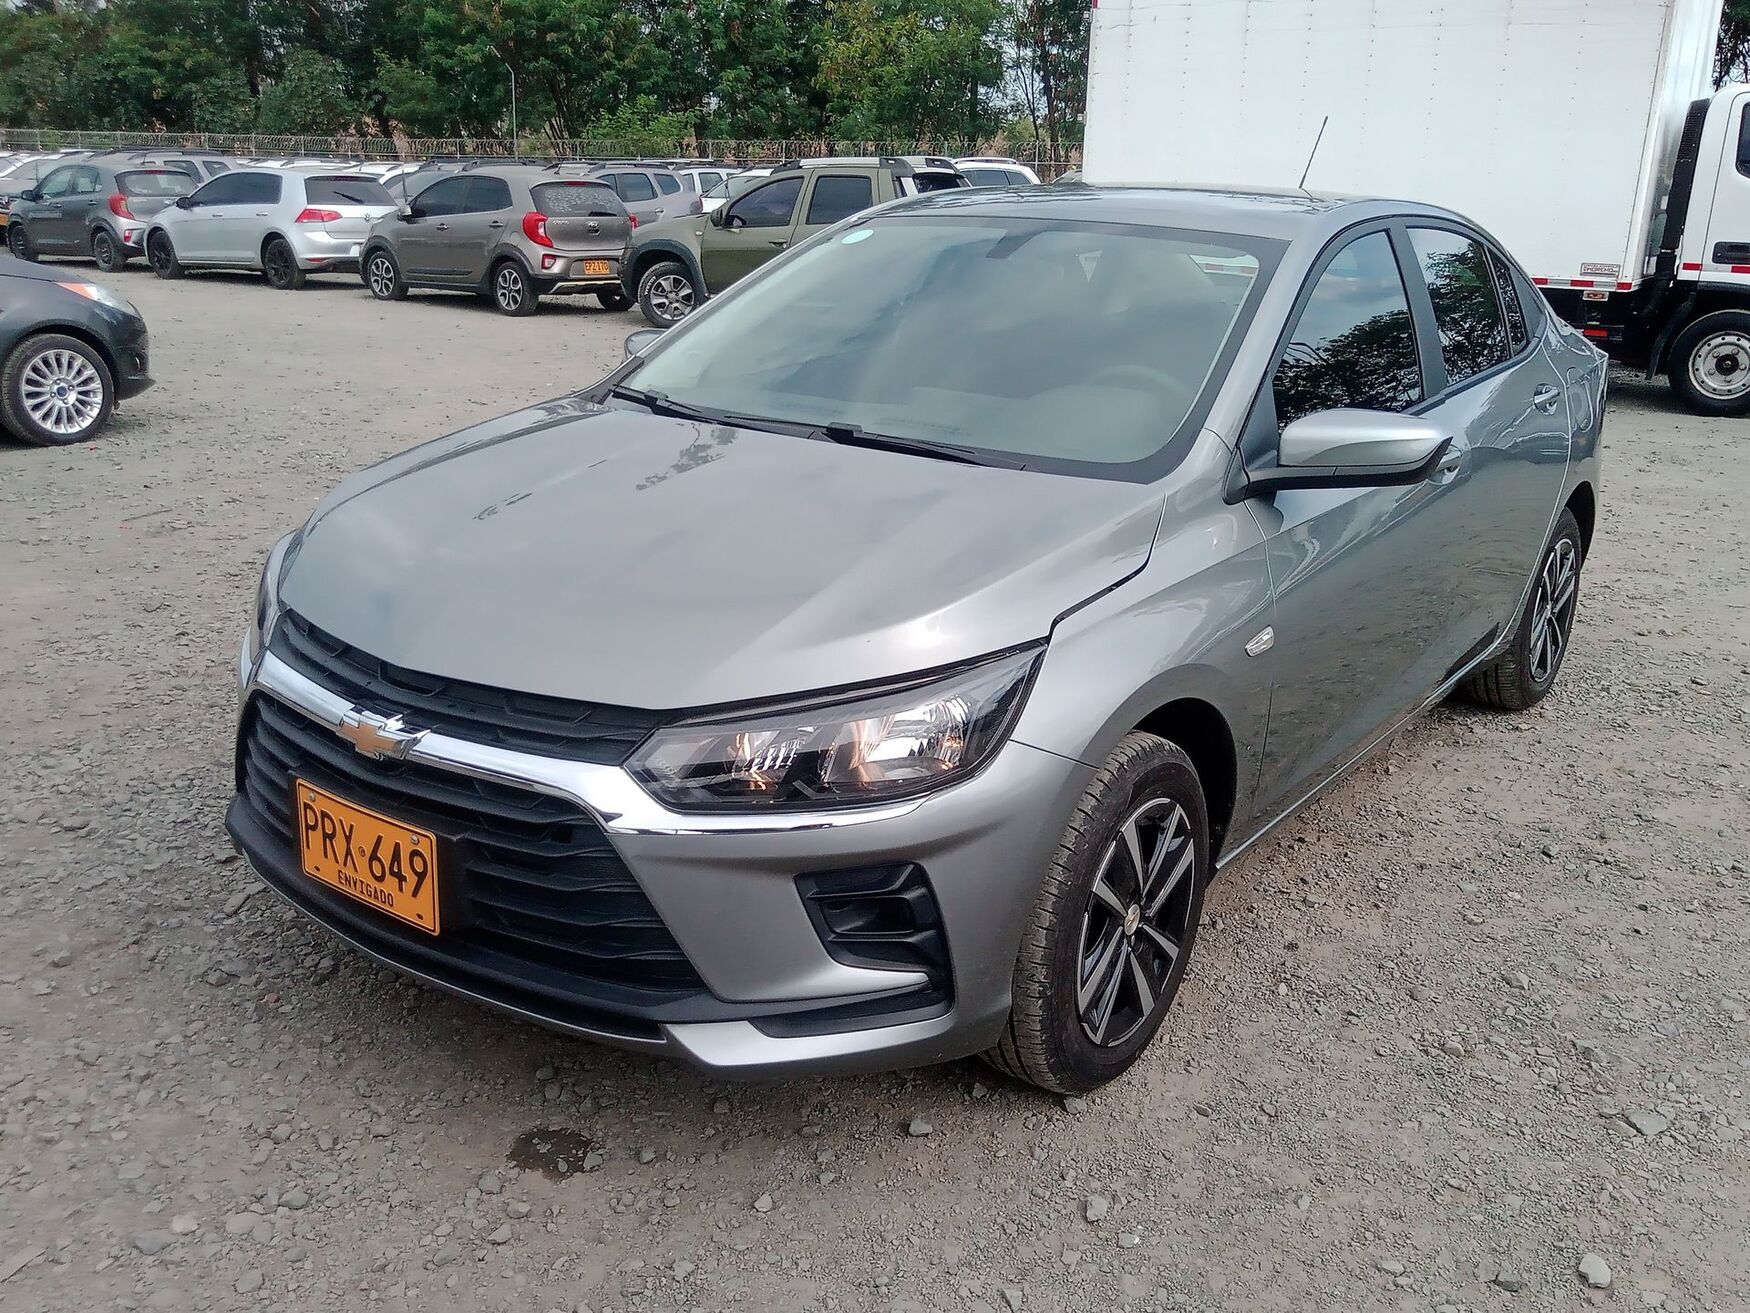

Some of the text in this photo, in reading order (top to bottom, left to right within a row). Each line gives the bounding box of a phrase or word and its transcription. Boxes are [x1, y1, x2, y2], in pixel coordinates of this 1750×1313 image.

[303, 800, 429, 898] PRX 649
[337, 869, 394, 908] ENVIGADO
